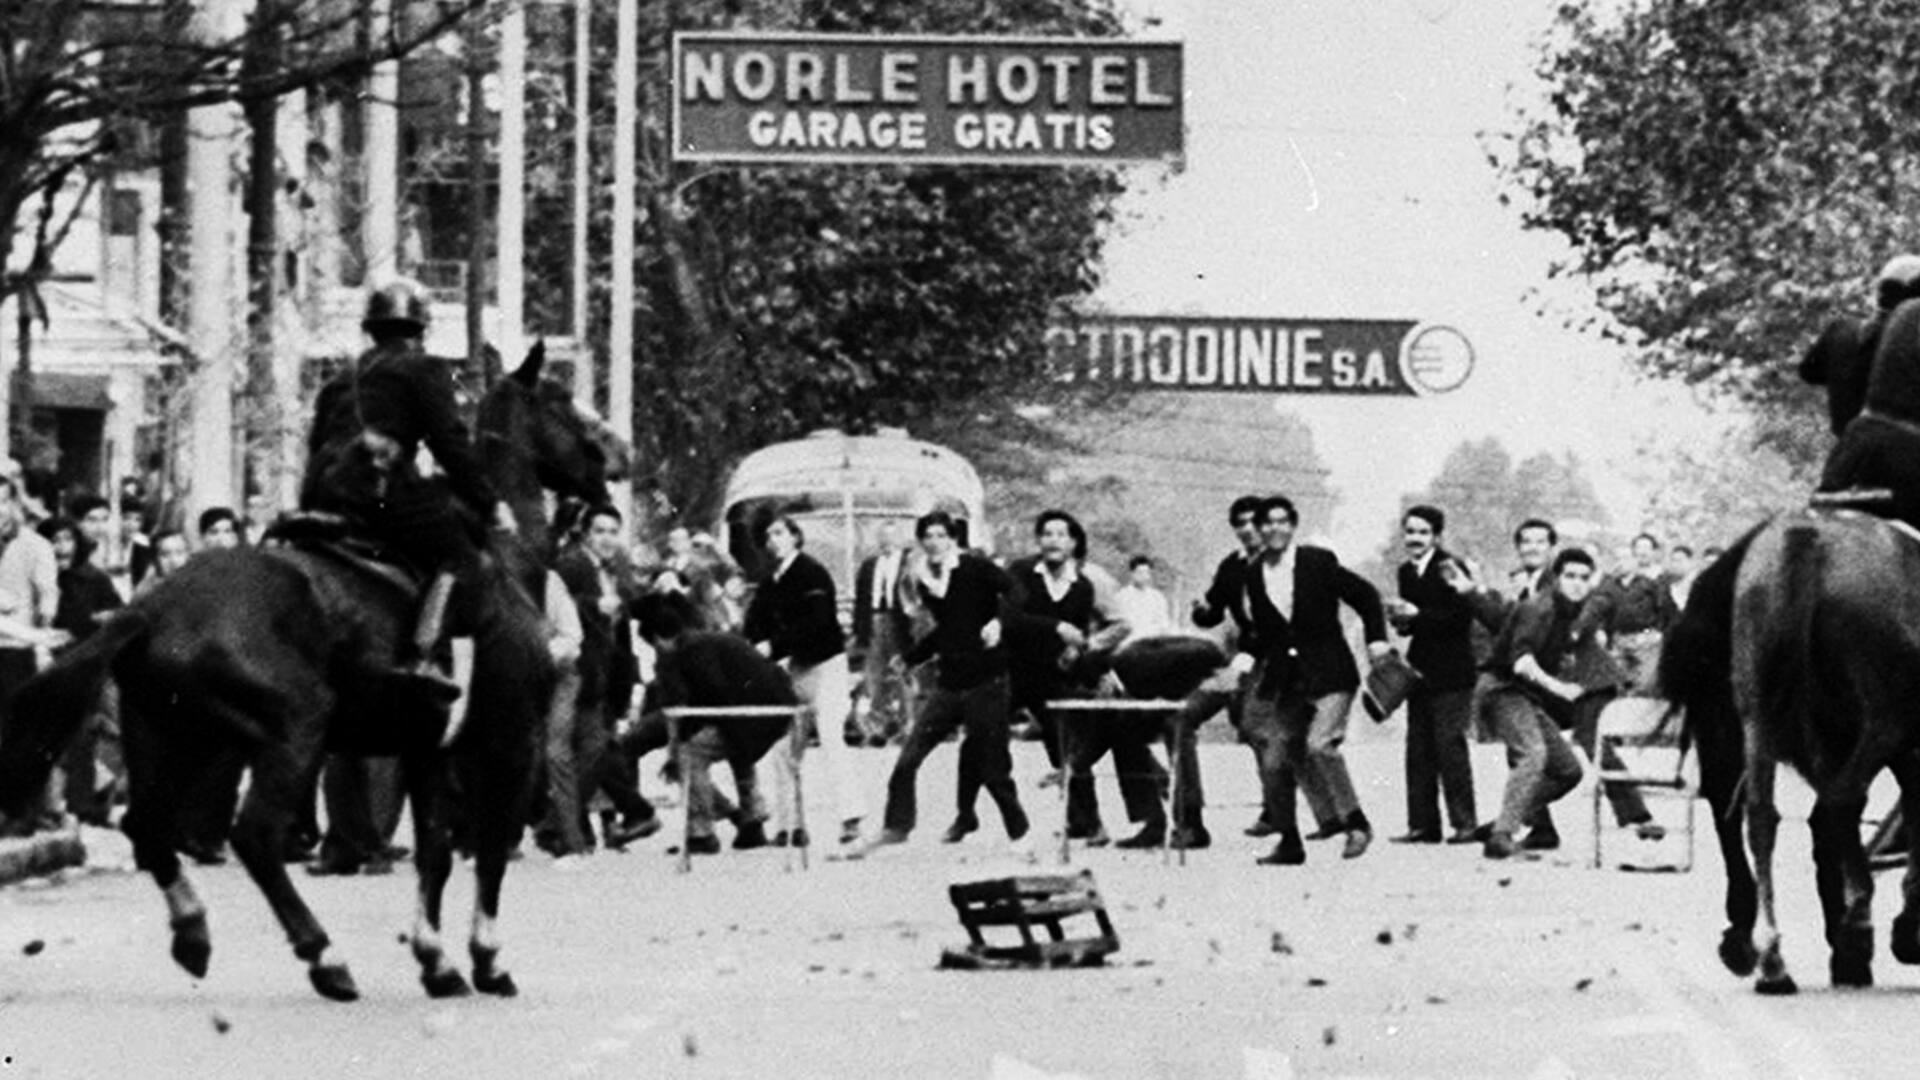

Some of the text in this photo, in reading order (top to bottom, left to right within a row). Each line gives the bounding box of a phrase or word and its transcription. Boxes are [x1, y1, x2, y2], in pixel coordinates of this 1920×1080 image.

[684, 51, 1174, 104] NORLE HOTEL
[747, 110, 1115, 150] GARAGE GRATIS
[1332, 350, 1395, 388] S.A.
